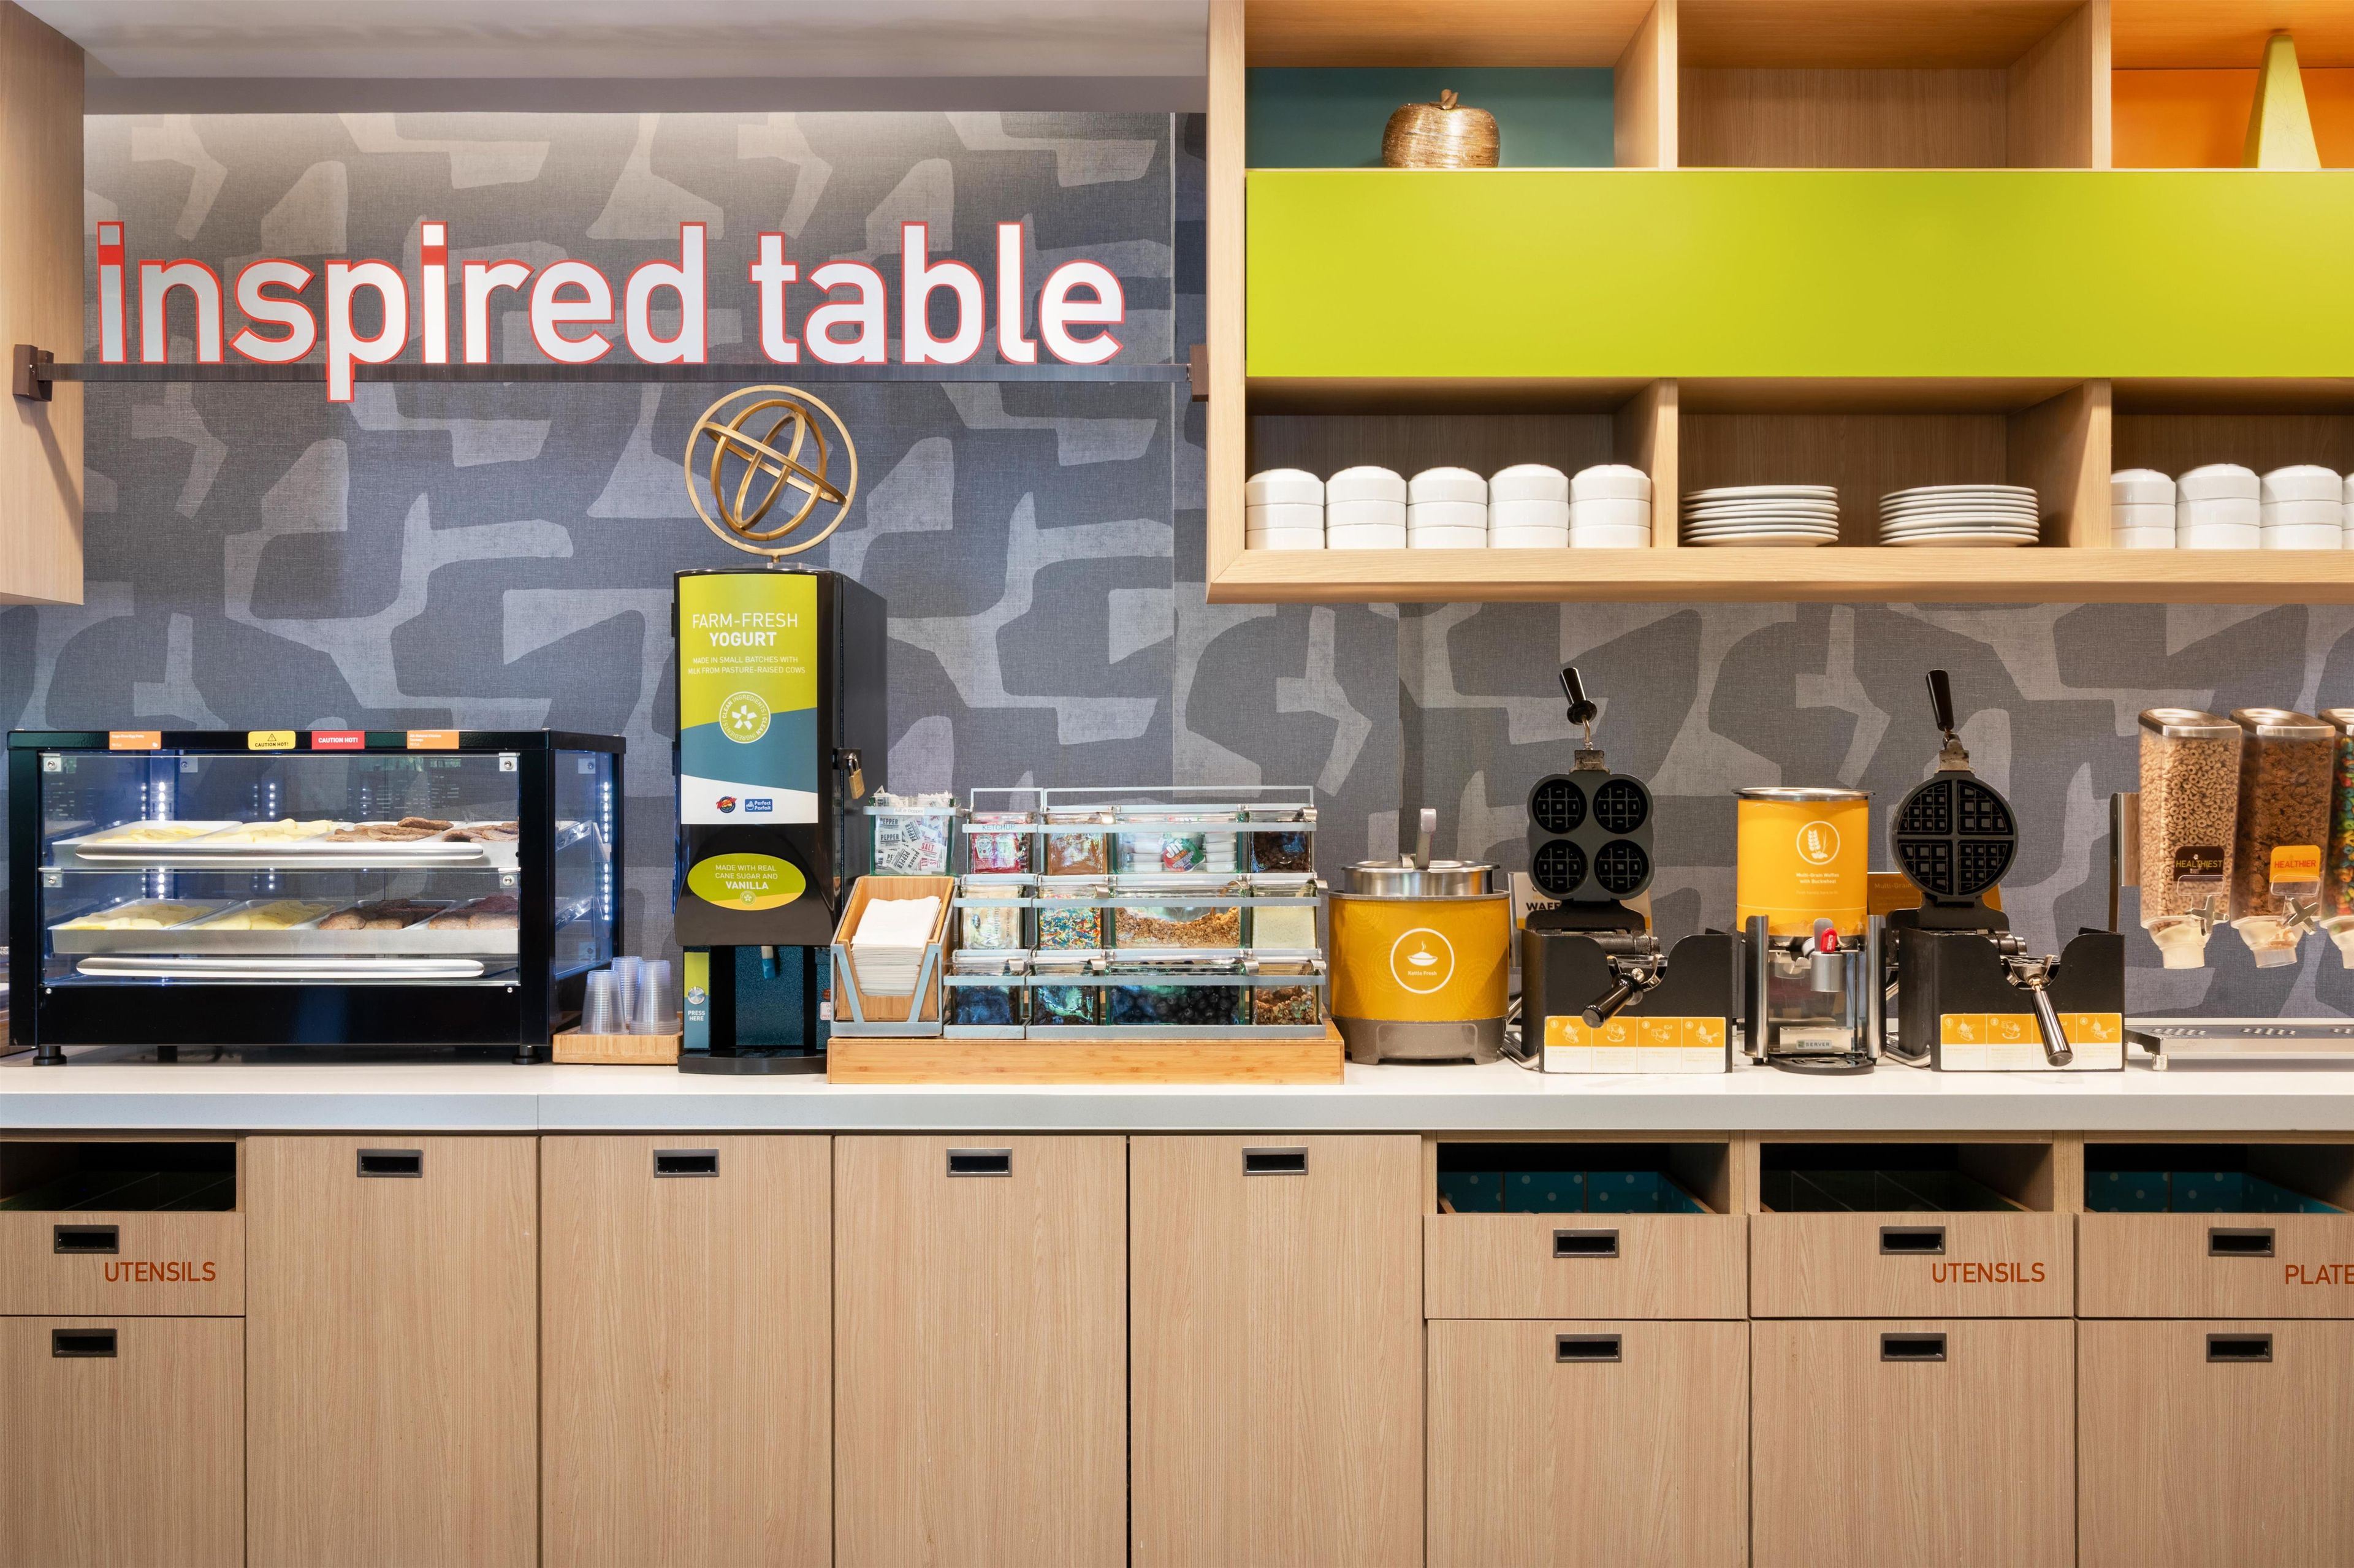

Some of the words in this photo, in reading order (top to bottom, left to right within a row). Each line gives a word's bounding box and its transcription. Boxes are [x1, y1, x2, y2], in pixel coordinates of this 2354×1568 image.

[97, 221, 707, 402] inspired
[748, 222, 1125, 365] table
[693, 613, 798, 628] FARM-FRESH
[709, 632, 777, 647] YOGURT
[722, 701, 733, 718] CLEAN
[733, 695, 766, 713] INGREDIENTS
[723, 722, 756, 740] INGREDIENTS
[756, 717, 768, 735] CLEAN
[905, 823, 918, 842] PEPPER
[921, 842, 935, 851] SALT
[897, 851, 910, 869] PEPPER
[2274, 859, 2316, 868] HEALTHIER
[725, 881, 769, 889] VANILLA
[105, 1262, 216, 1282] UTENSILS
[1932, 1263, 2045, 1283] UTENSILS
[2285, 1265, 2354, 1285] PLATE
